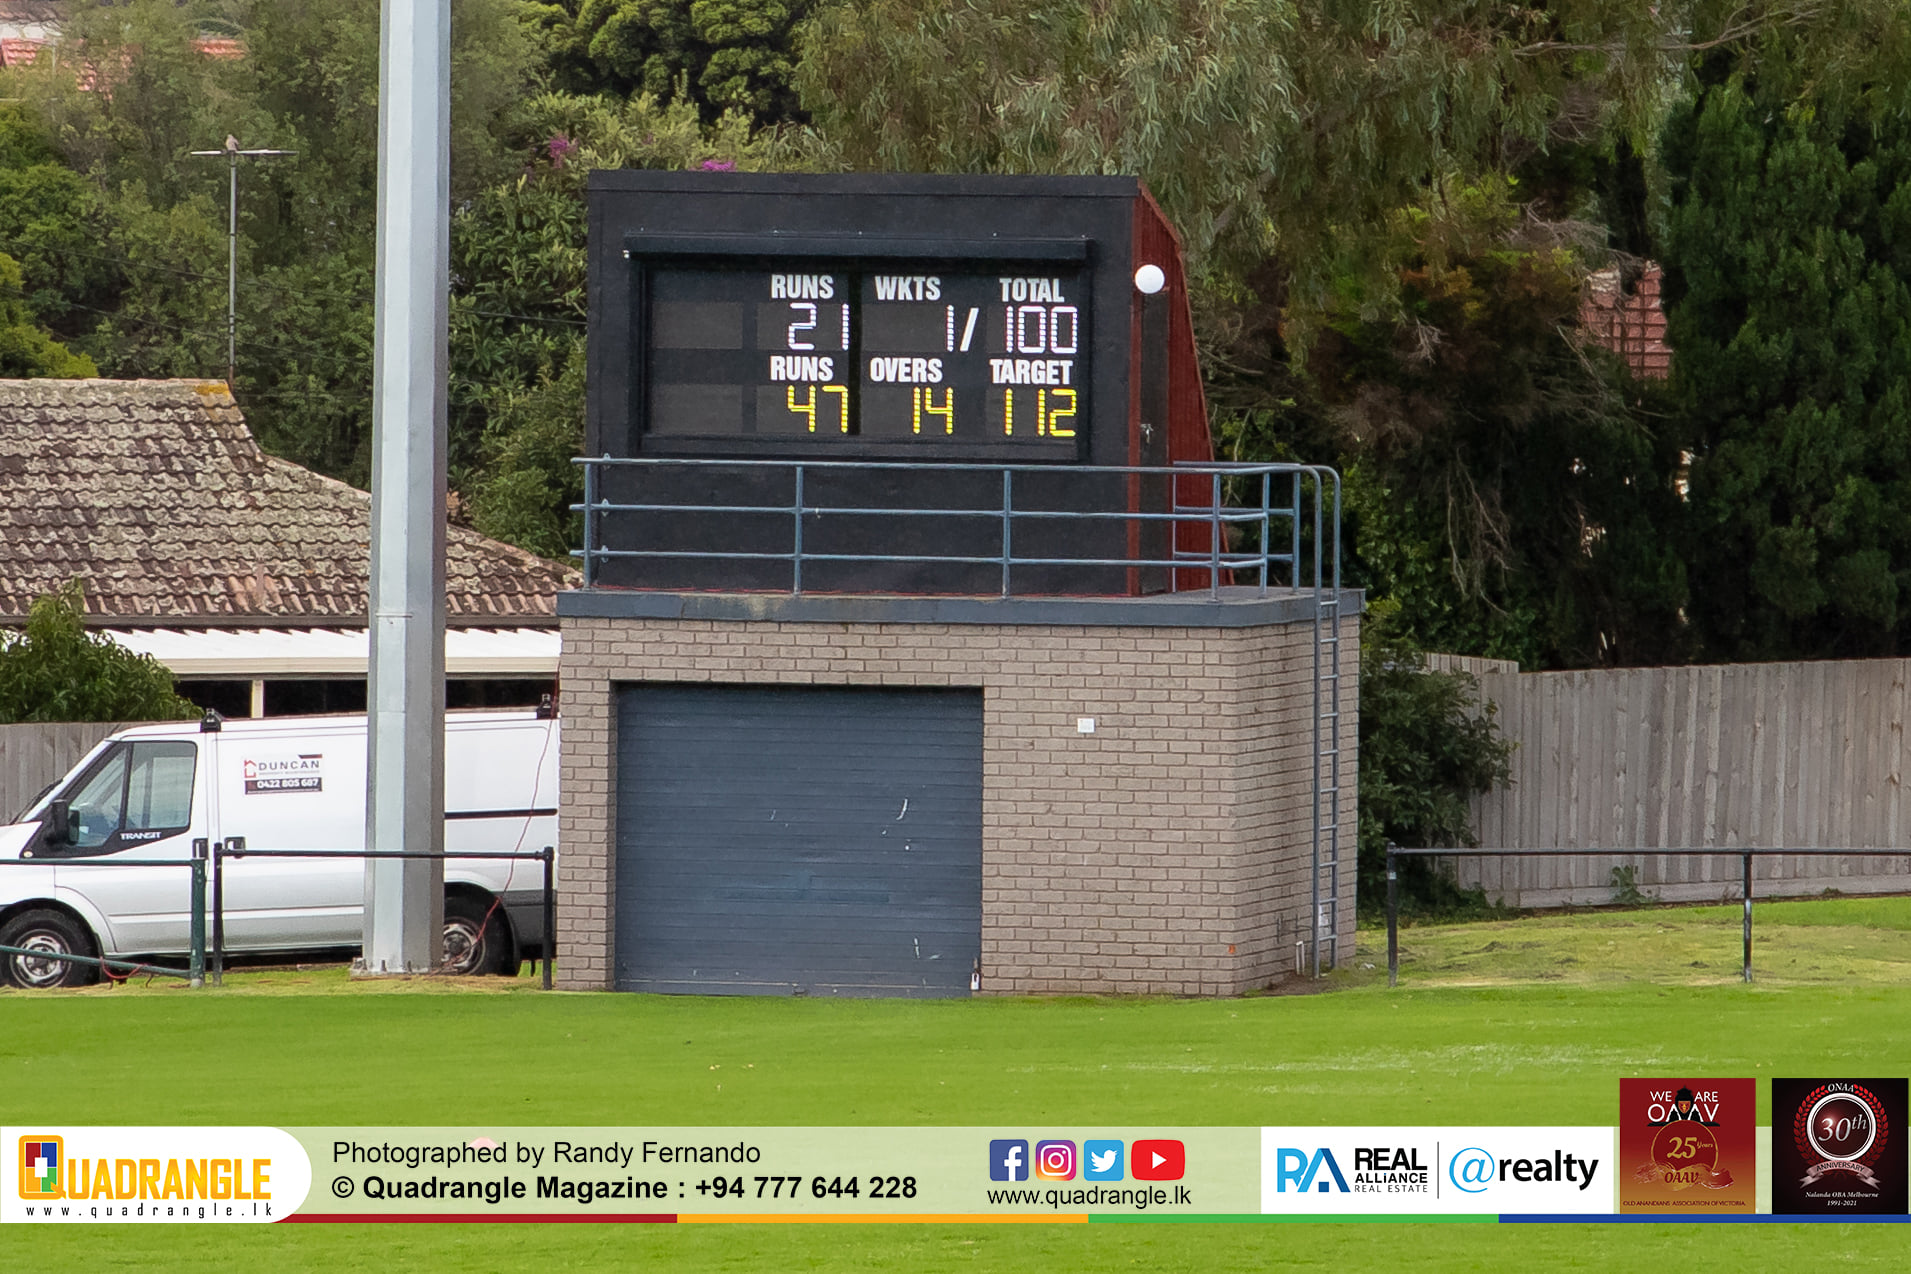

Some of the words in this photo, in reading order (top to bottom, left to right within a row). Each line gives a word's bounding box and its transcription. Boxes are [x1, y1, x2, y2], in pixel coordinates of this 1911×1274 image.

[771, 274, 834, 299] RUNS
[875, 276, 941, 300] WKTS
[999, 277, 1065, 302] TOTAL
[788, 302, 849, 351] 21
[1006, 305, 1078, 354] 100
[770, 355, 834, 382] RUNS
[870, 357, 943, 383] OVERS
[989, 358, 1073, 385] TARGET
[787, 385, 849, 433] 47
[913, 386, 953, 435] 14
[1005, 388, 1077, 437] 112
[258, 760, 320, 771] DUNCAN
[120, 831, 162, 840] TRANSIT
